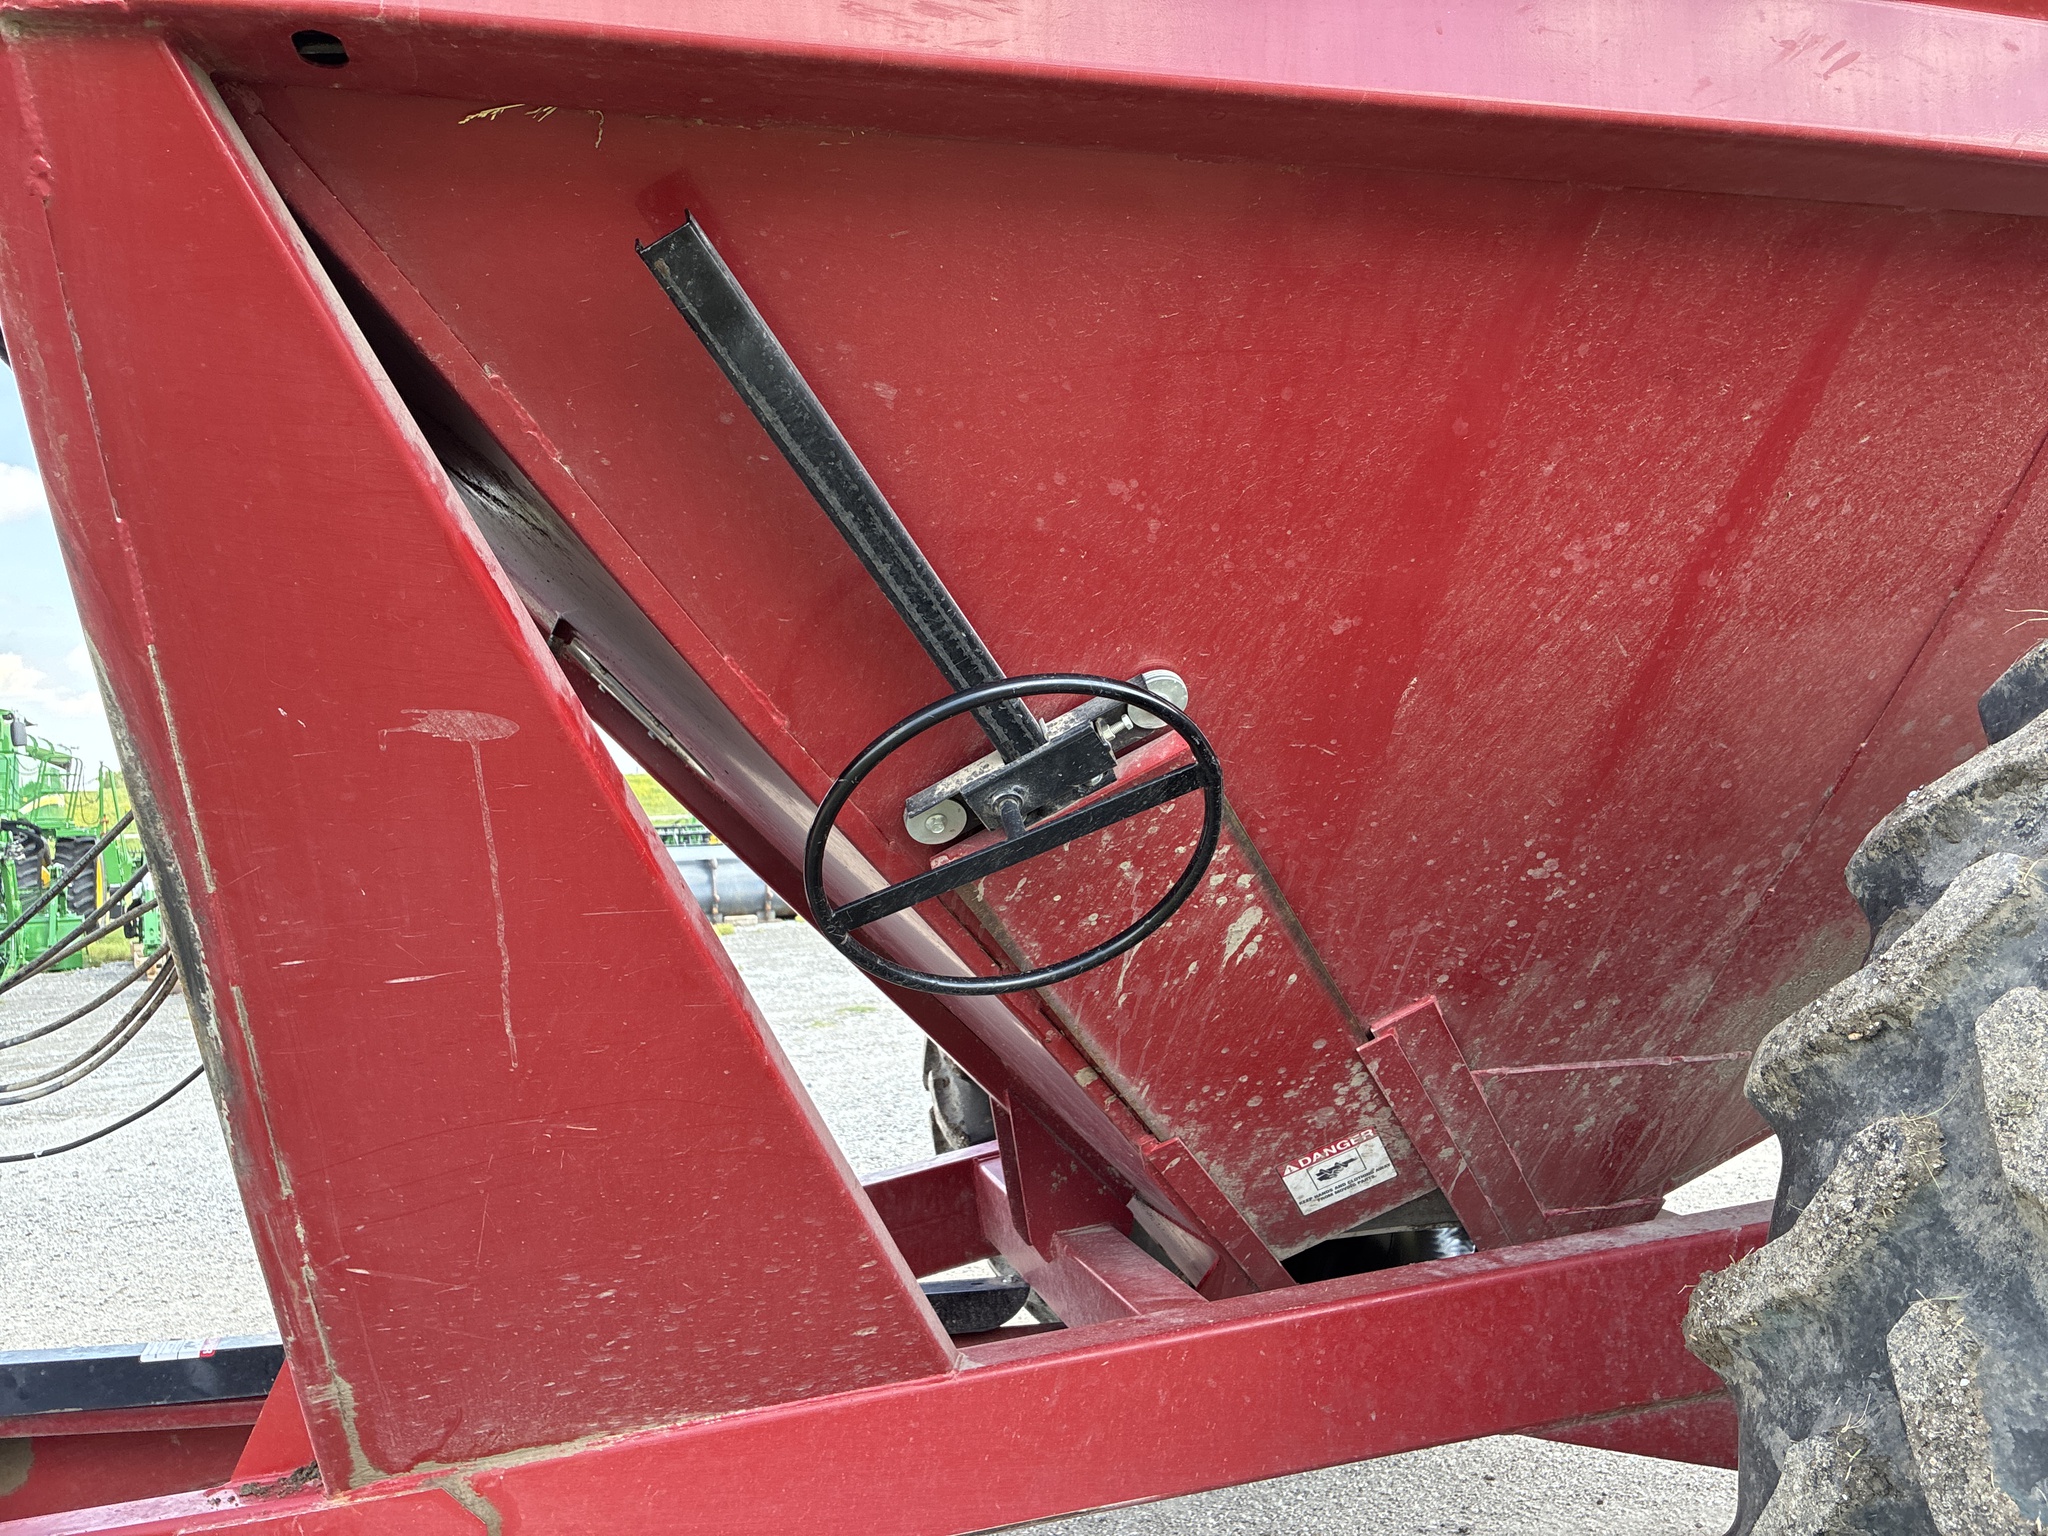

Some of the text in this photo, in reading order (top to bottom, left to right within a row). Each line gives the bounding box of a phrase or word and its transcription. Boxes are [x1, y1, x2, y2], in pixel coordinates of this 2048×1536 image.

[1298, 1129, 1374, 1167] DANGER
[1299, 1163, 1391, 1205] KEEP HANDS AND CLOTHING AWAY
[1317, 1193, 1334, 1202] FROM
[1334, 1183, 1356, 1195] MOVING
